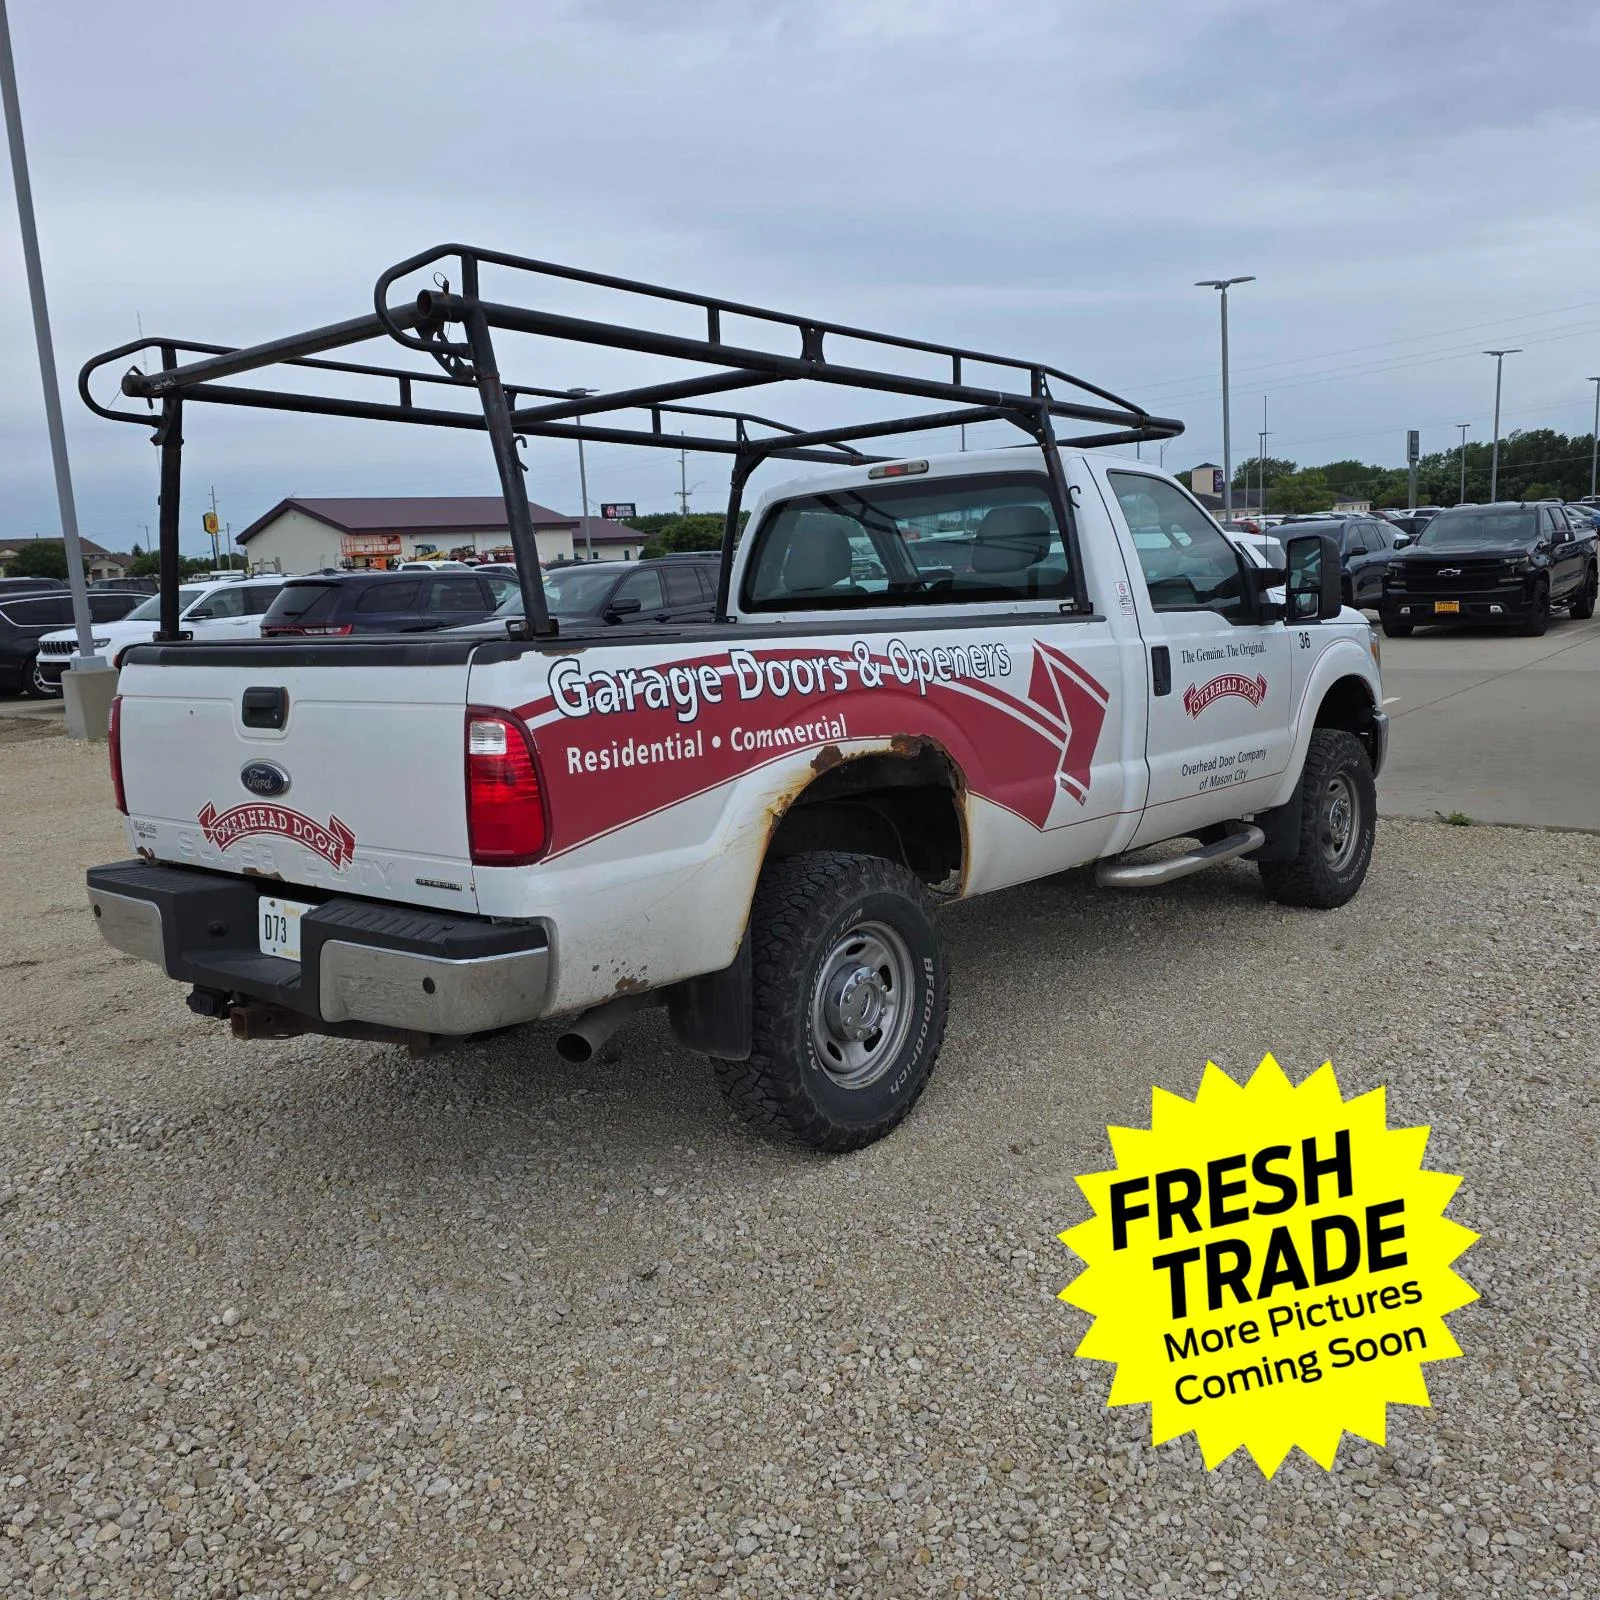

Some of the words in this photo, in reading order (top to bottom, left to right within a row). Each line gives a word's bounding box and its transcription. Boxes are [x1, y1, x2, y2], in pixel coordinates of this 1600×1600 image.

[1181, 650, 1195, 665] The
[1226, 644, 1239, 658] The
[1299, 631, 1311, 649] 36
[547, 657, 723, 724] Garage
[728, 649, 848, 701] Doors
[852, 640, 885, 689] &
[886, 638, 1012, 697] Openers
[1193, 678, 1237, 712] OVERHEAD
[1239, 680, 1260, 703] DOOR
[566, 729, 703, 774] Residential
[730, 712, 847, 752] Commercial
[1181, 757, 1217, 777] Overhead
[1218, 756, 1236, 769] Door
[1237, 747, 1268, 764] Company
[247, 767, 273, 790] Ford
[1199, 776, 1209, 791] of
[1209, 773, 1233, 788] Mason
[1234, 768, 1249, 782] City
[215, 809, 288, 842] OVERHEAD
[292, 817, 338, 861] DOOR
[264, 913, 287, 944] D73
[890, 956, 936, 1095] BFGoodrich
